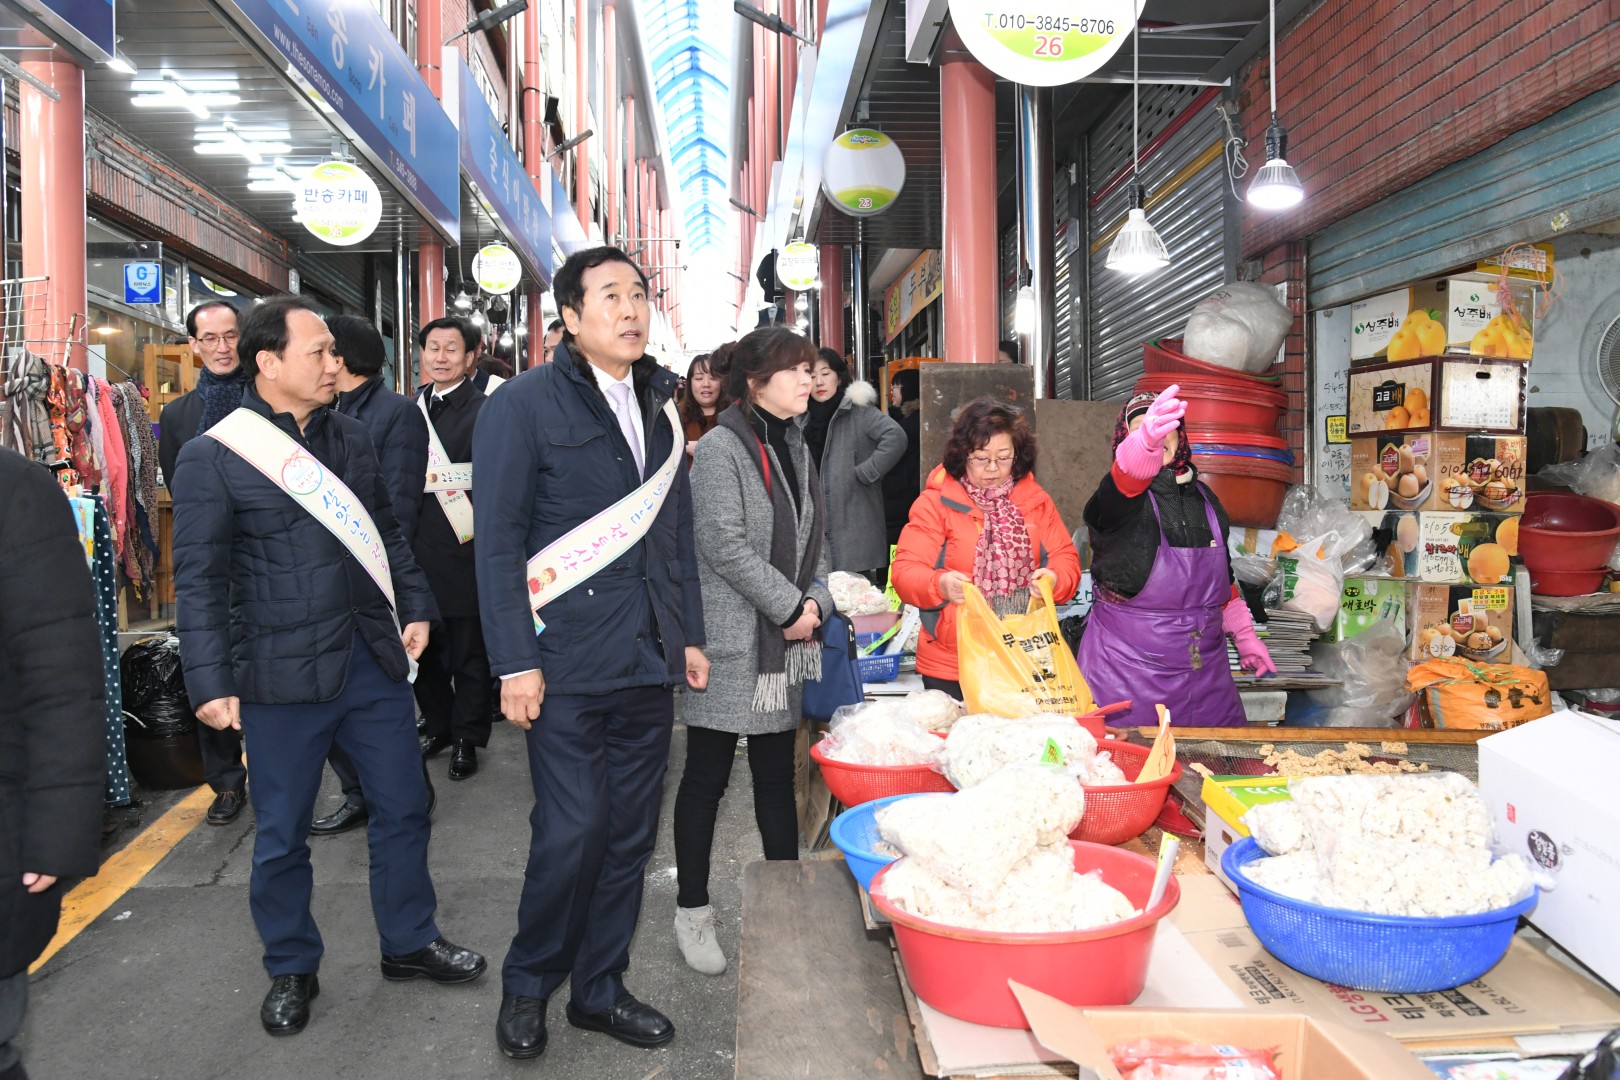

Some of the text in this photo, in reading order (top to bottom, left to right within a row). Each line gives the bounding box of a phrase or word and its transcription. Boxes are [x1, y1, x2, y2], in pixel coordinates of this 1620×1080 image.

[984, 12, 1115, 35] T.010-3845-8706
[1034, 35, 1063, 56] 26
[304, 187, 369, 205] 반송카페
[858, 198, 873, 209] 23
[136, 266, 148, 281] G
[1453, 306, 1492, 320] 상주배
[1365, 316, 1400, 333] 상주배
[1375, 390, 1390, 402] 고급
[1342, 599, 1377, 613] 애호박
[1350, 1003, 1390, 1025] LG
[1383, 994, 1425, 1020] 테크
